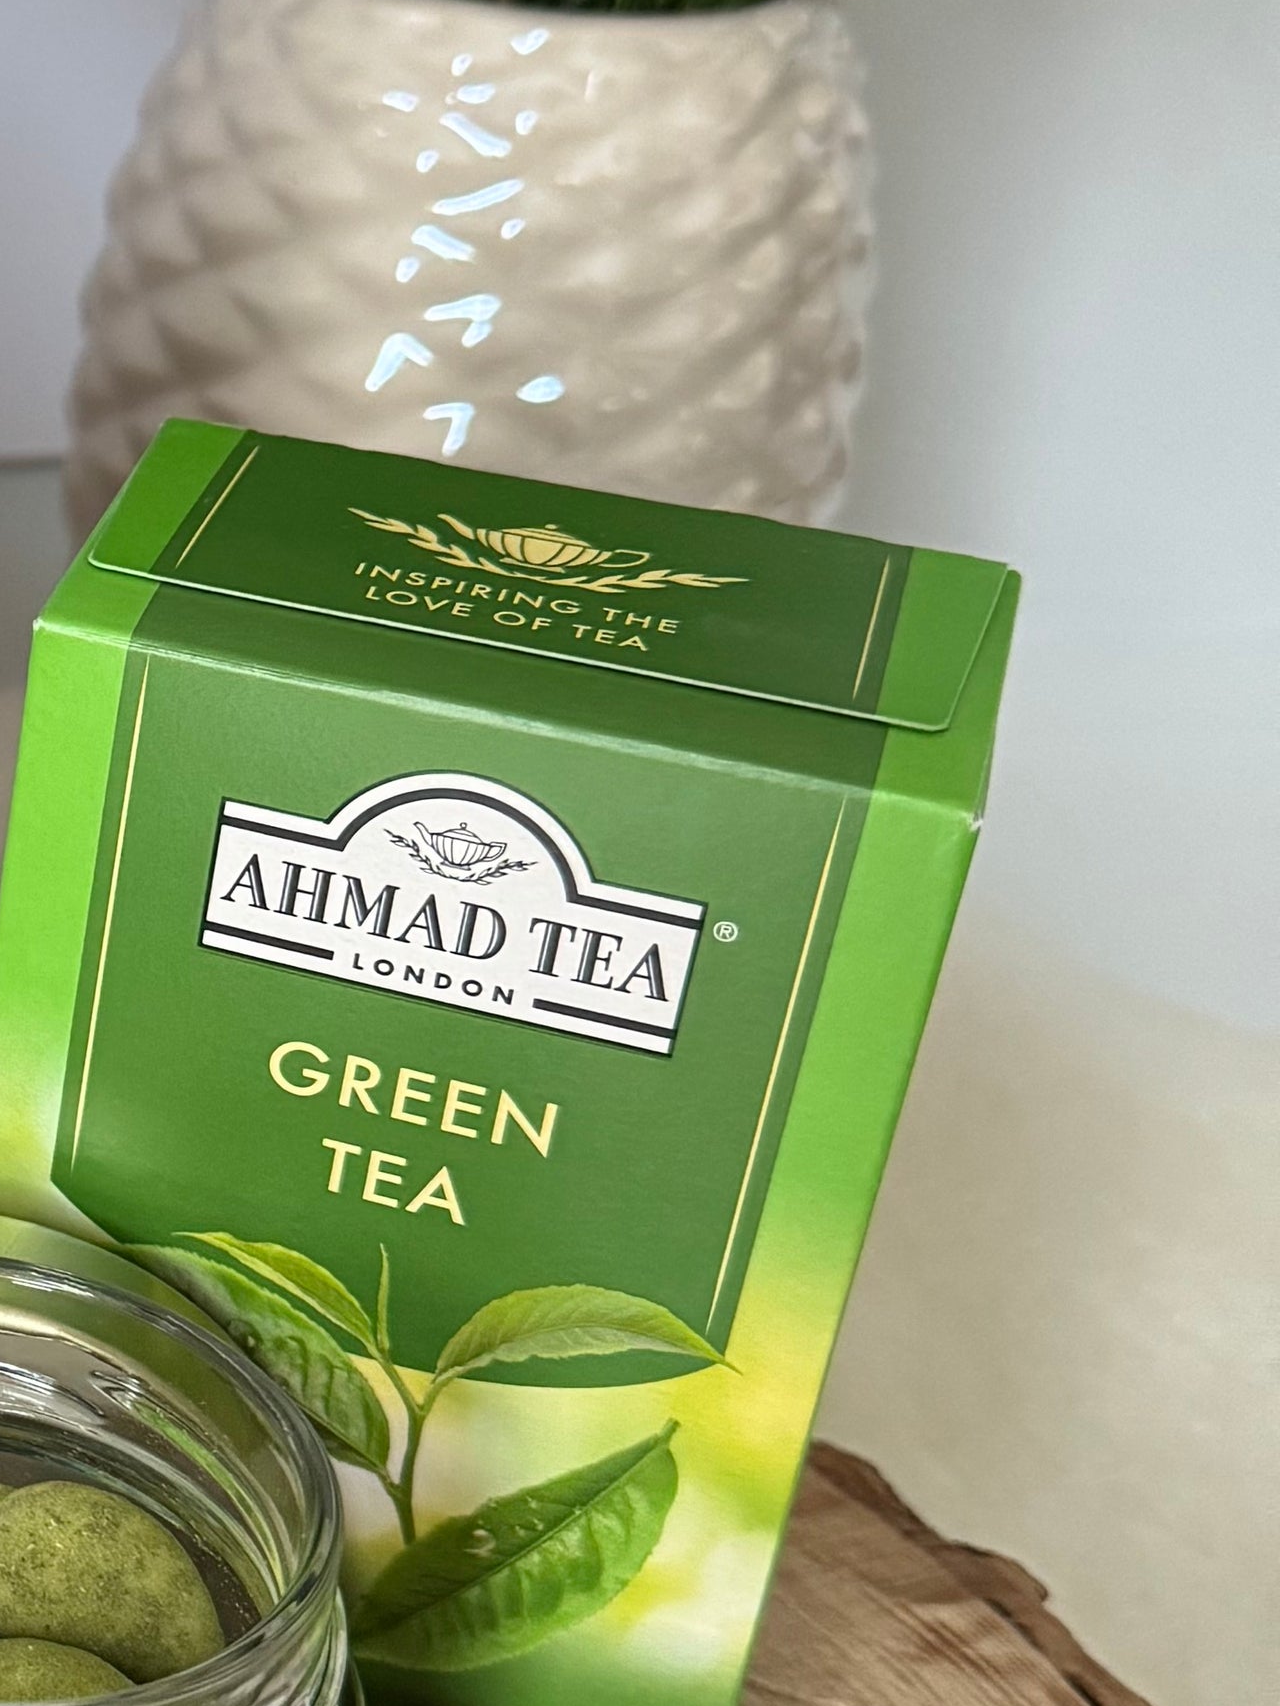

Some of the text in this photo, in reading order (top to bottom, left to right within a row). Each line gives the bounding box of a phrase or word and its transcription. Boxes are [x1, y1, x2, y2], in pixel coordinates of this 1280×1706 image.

[354, 562, 682, 635] INSPIRING THE
[365, 586, 650, 652] LOVE OF TEA
[220, 851, 671, 1003] AHMAD TEA
[351, 951, 516, 1007] LONDON
[267, 1039, 560, 1160] GREEN
[320, 1137, 468, 1227] TEA
